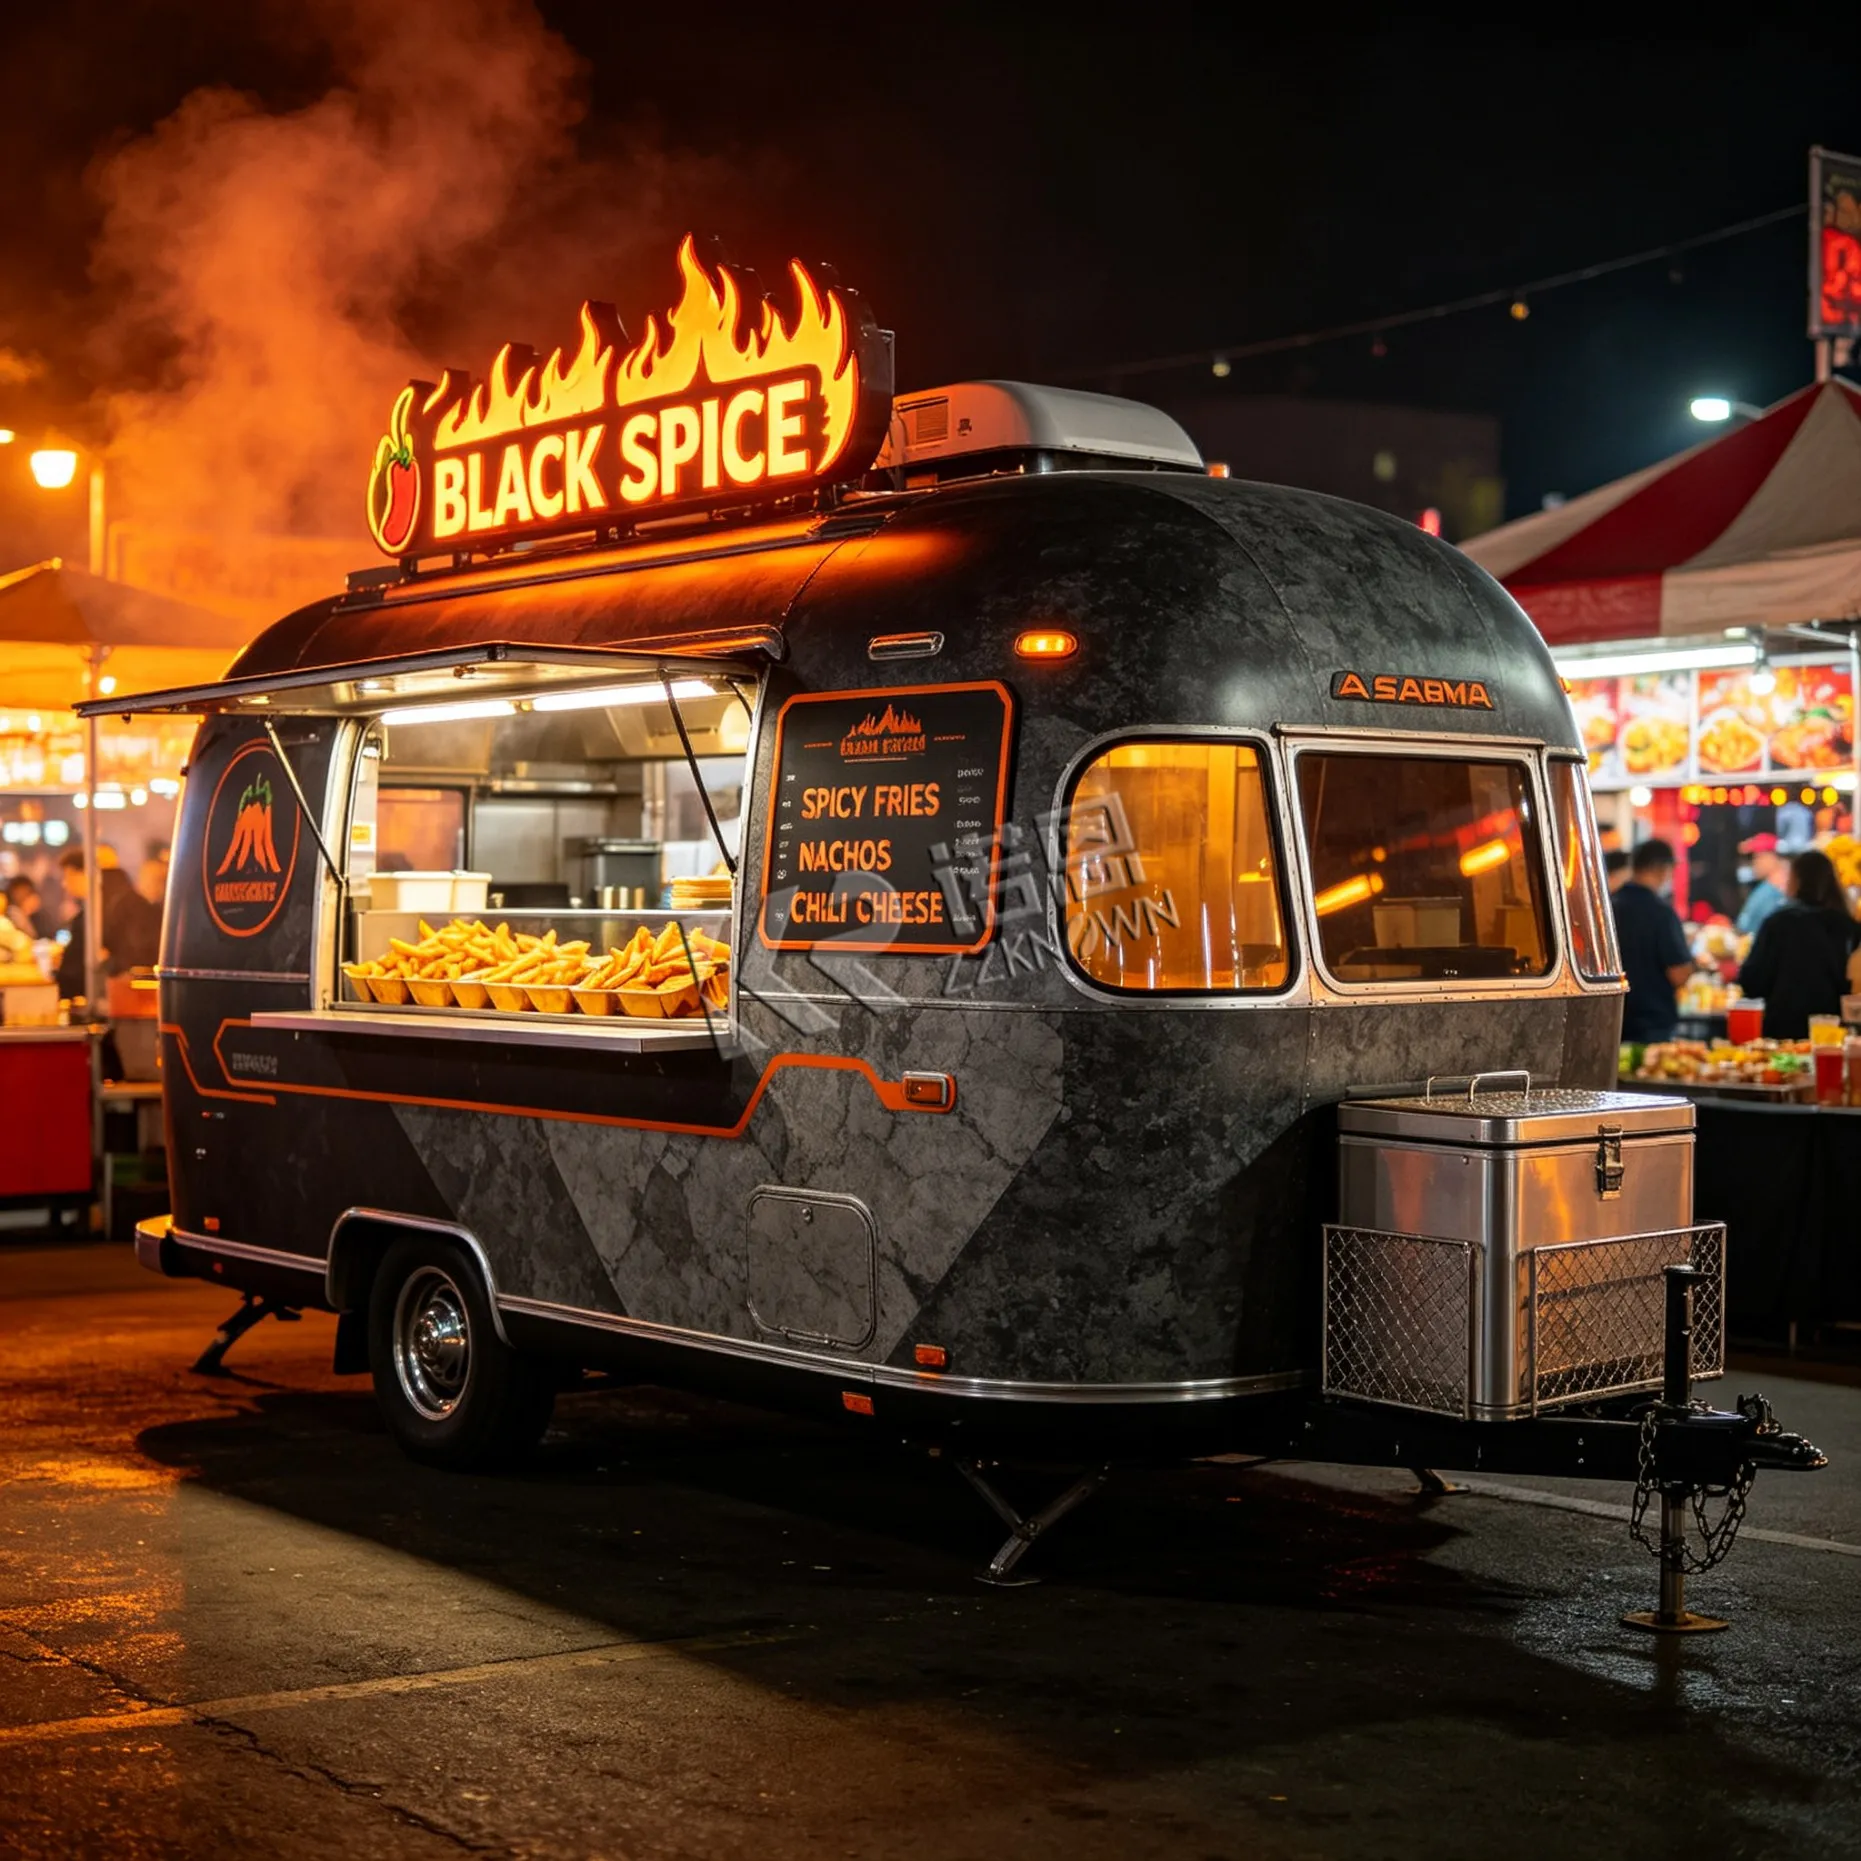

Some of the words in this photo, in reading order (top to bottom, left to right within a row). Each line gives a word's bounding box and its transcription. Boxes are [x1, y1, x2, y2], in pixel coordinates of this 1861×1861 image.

[433, 423, 606, 540] BLACK
[619, 380, 811, 504] SPICE
[801, 784, 868, 819] SPICY
[874, 782, 941, 818] FRIES
[799, 839, 892, 872] NACHOS
[790, 891, 848, 924] CHILI
[856, 891, 944, 924] CHEESE
